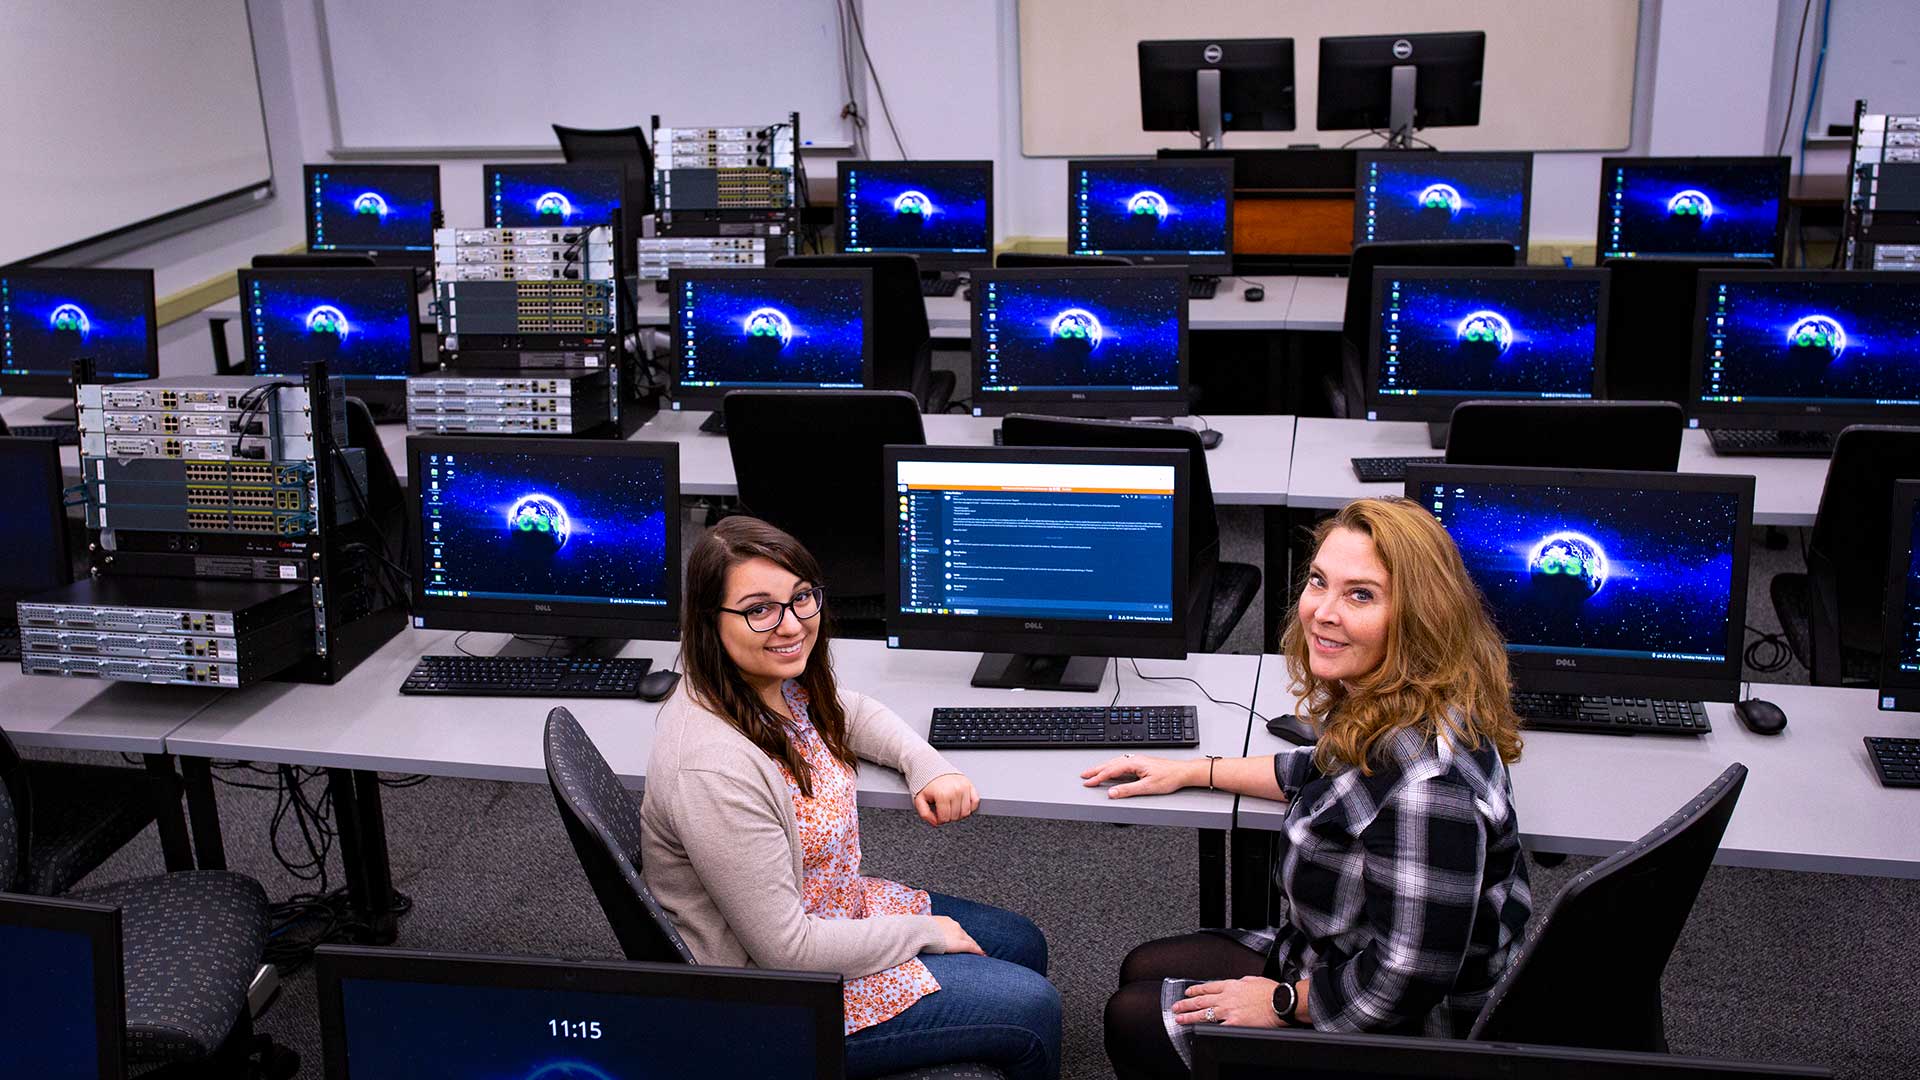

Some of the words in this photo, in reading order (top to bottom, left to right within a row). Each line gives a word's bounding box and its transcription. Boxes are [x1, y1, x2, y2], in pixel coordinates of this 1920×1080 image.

[535, 604, 552, 612] DELL
[1024, 622, 1043, 631] DELL
[1555, 658, 1577, 668] DELL
[548, 1019, 602, 1040] 11:15
